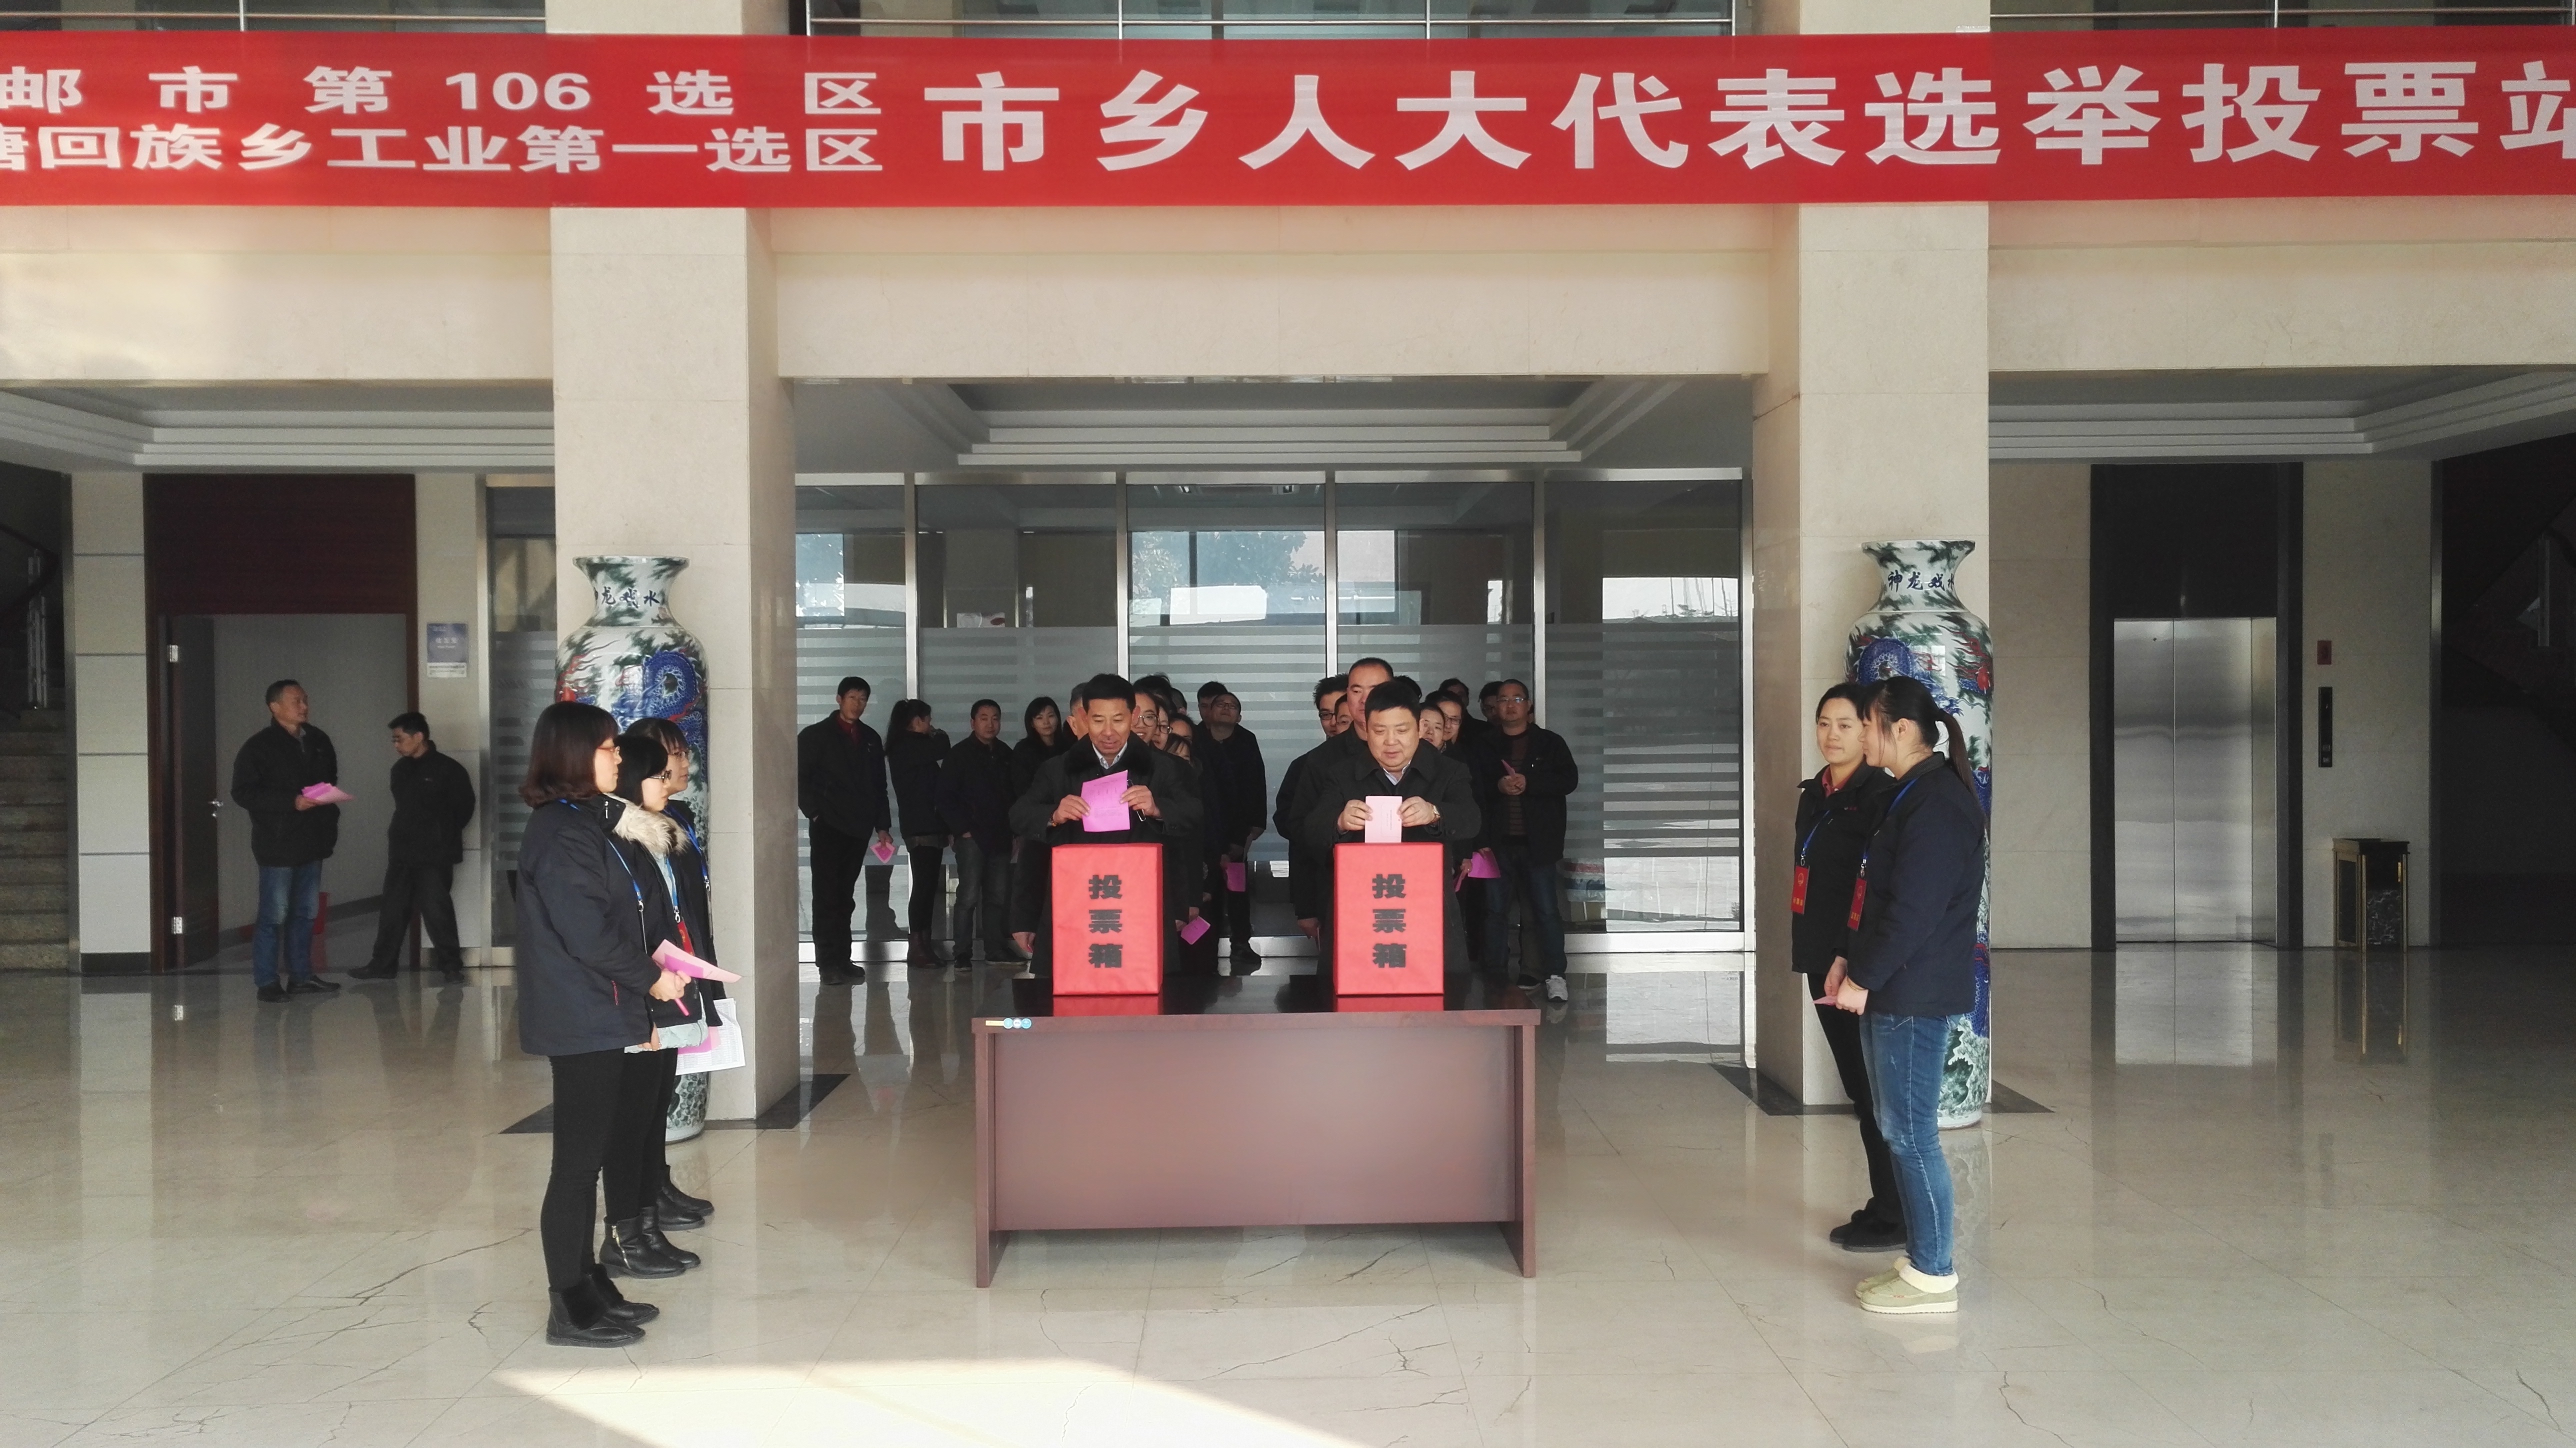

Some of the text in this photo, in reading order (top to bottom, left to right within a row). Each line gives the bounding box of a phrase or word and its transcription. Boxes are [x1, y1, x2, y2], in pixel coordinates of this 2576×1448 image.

[924, 60, 2576, 171] 市乡人大代表选举投票站
[594, 586, 660, 608] 龙戏水
[1088, 874, 1122, 968] 投票箱
[1372, 874, 1406, 968] 投票箱
